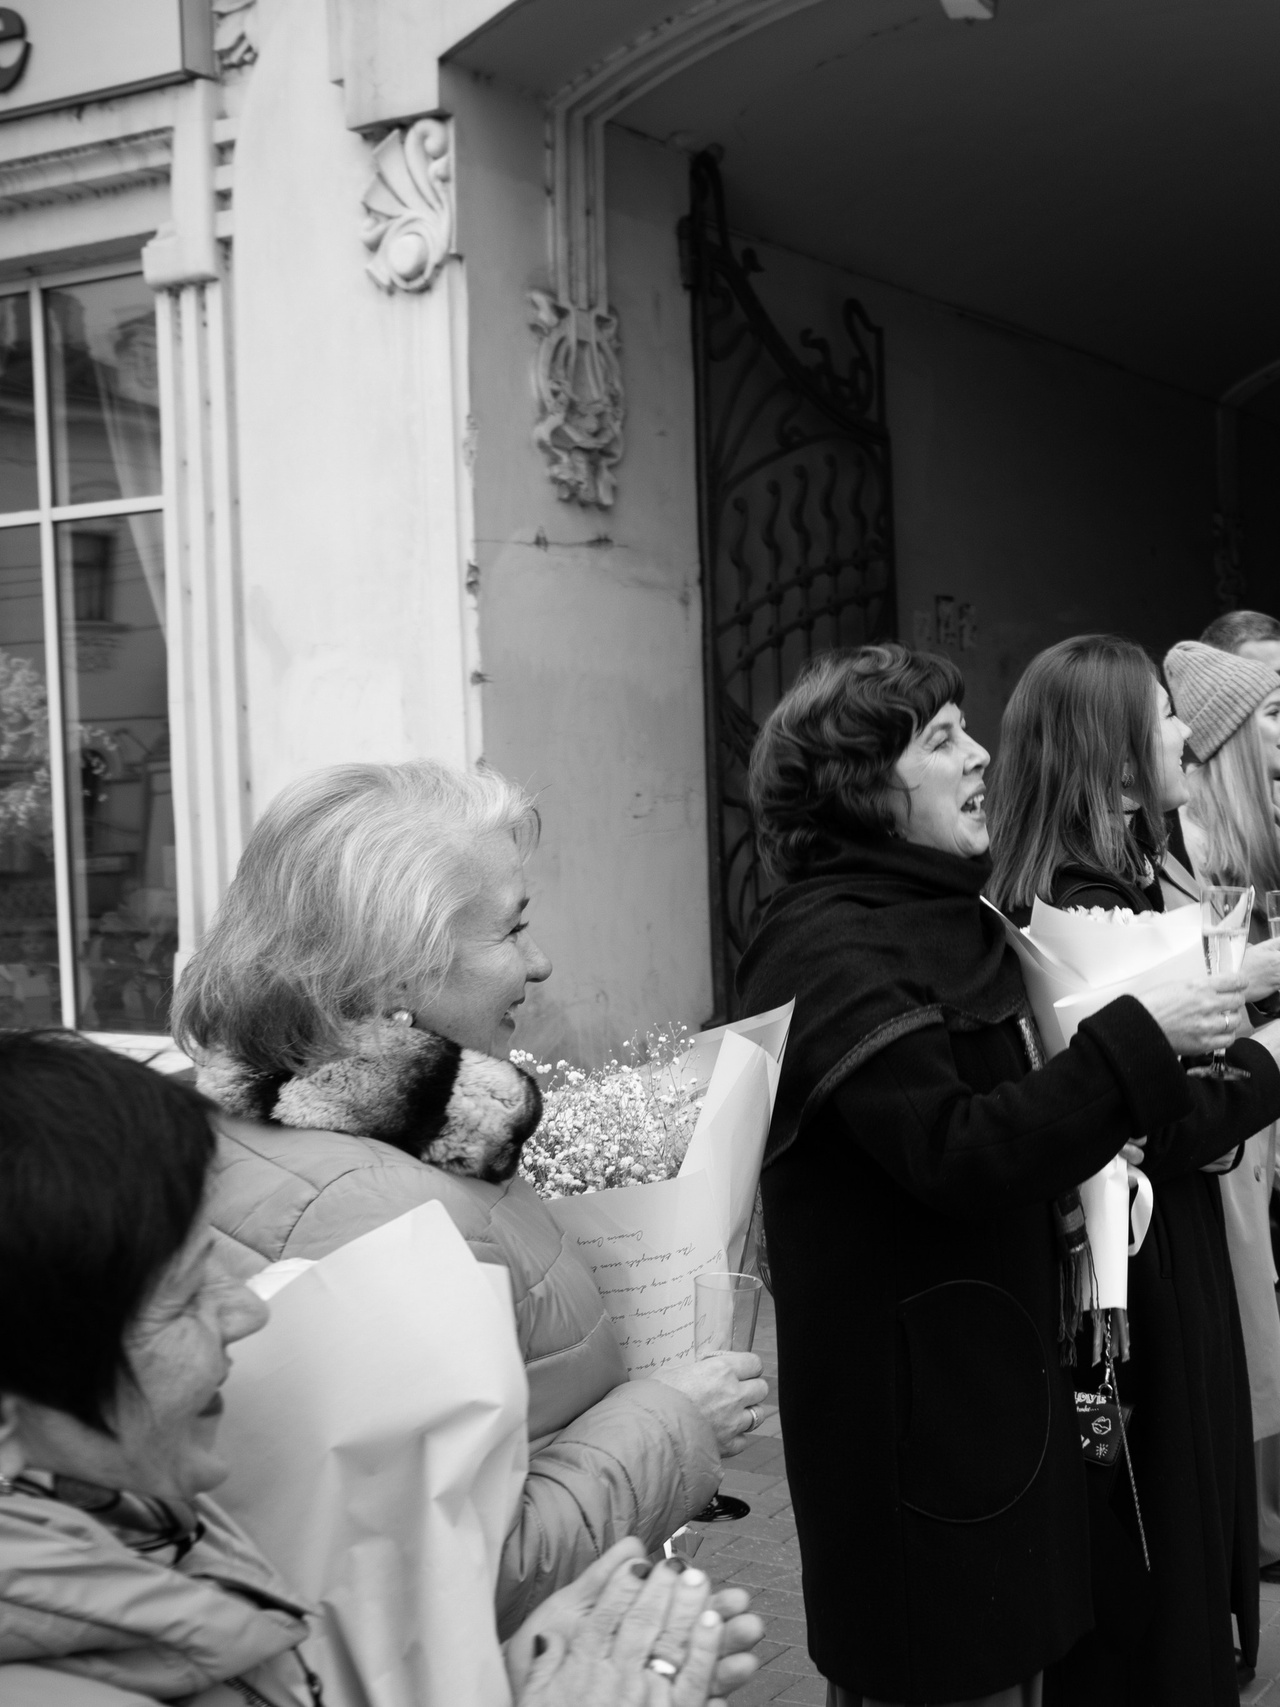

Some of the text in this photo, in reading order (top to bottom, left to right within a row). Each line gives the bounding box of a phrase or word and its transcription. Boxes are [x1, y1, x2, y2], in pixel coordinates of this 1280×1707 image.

[675, 1243, 696, 1256] The
[626, 1253, 672, 1267] thoughts
[671, 1275, 684, 1283] in
